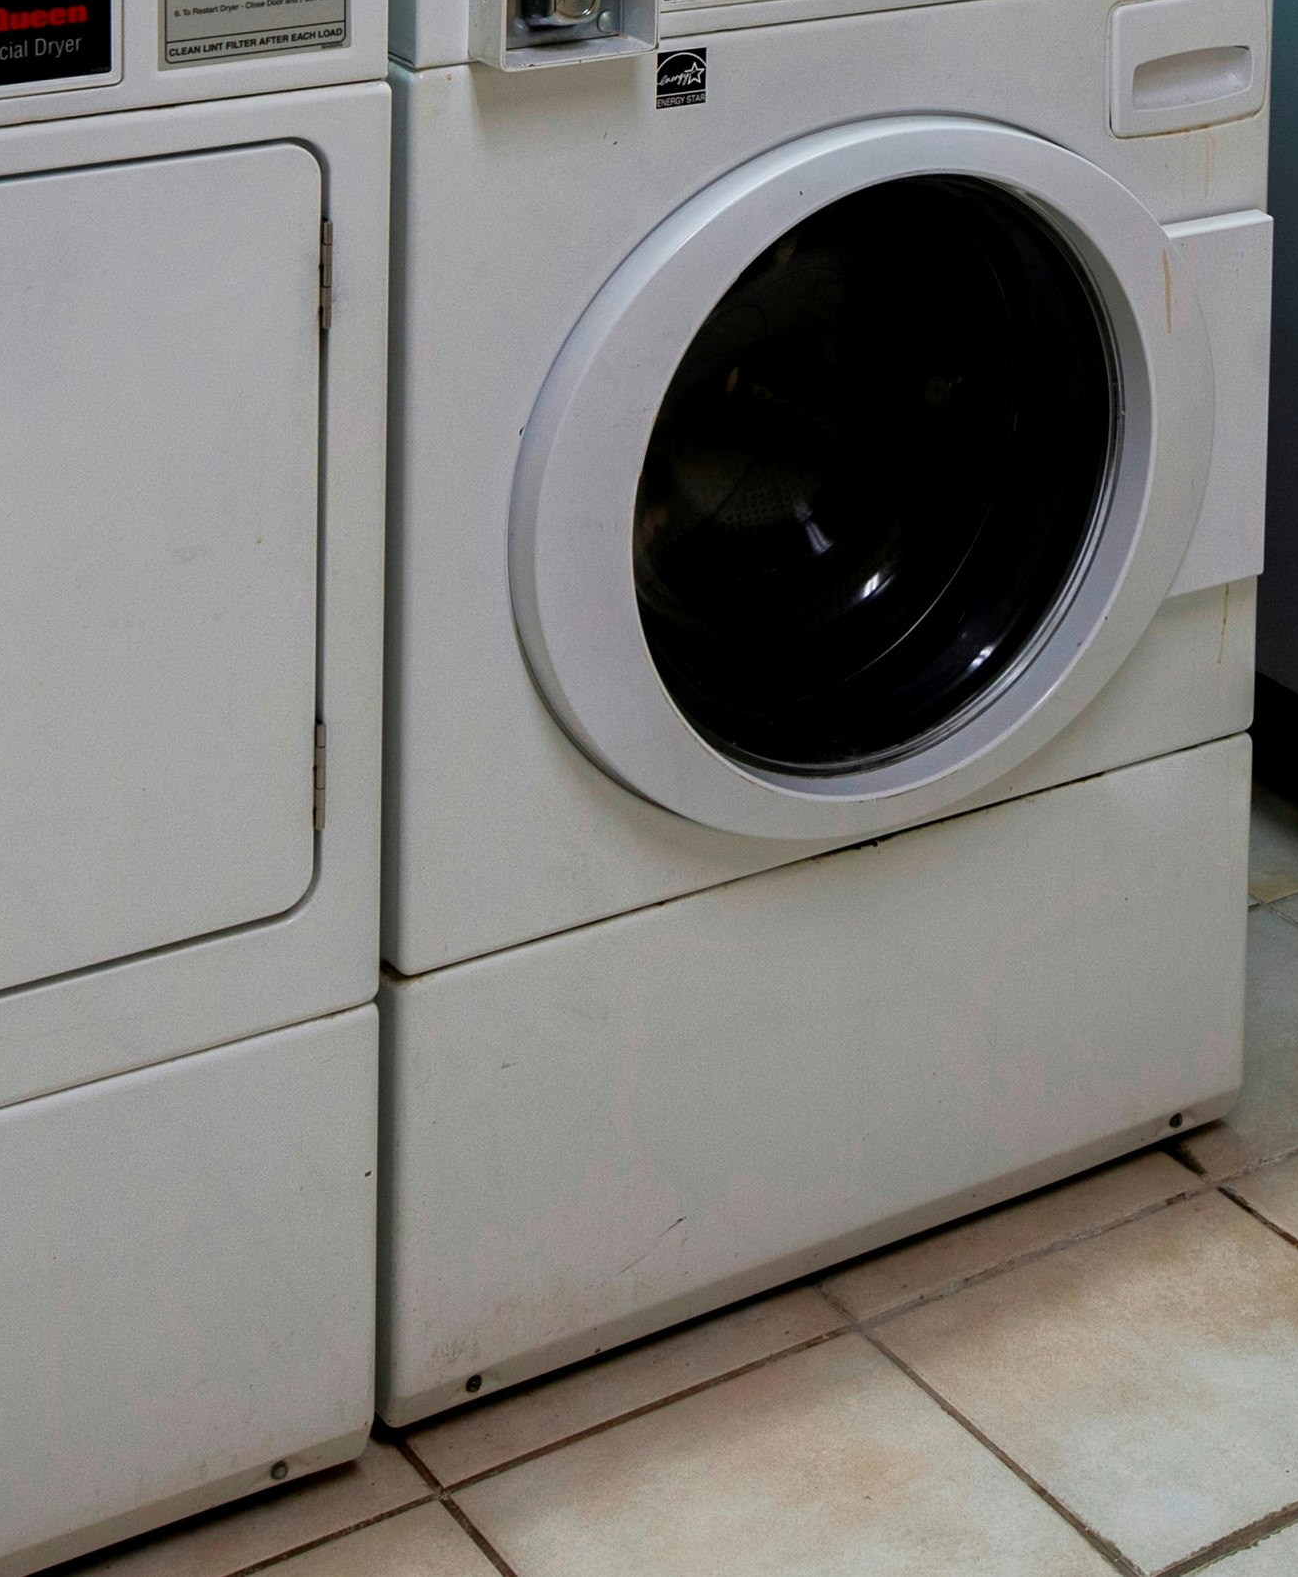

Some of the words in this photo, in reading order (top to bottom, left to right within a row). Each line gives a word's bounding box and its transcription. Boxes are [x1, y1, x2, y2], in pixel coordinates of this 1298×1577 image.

[174, 9, 181, 18] 6.
[182, 8, 192, 16] To
[192, 5, 219, 16] Restart
[220, 2, 240, 14] Dryer
[245, 0, 265, 10] Close
[34, 37, 82, 59] Dryer
[169, 45, 201, 57] CLEAN
[203, 42, 223, 53] LINT
[226, 38, 258, 50] FILTER
[259, 34, 289, 46] AFTER
[291, 31, 316, 42] EACH
[318, 27, 343, 39] LOAD
[657, 96, 685, 107] ENERGY
[686, 93, 705, 104] STAR
